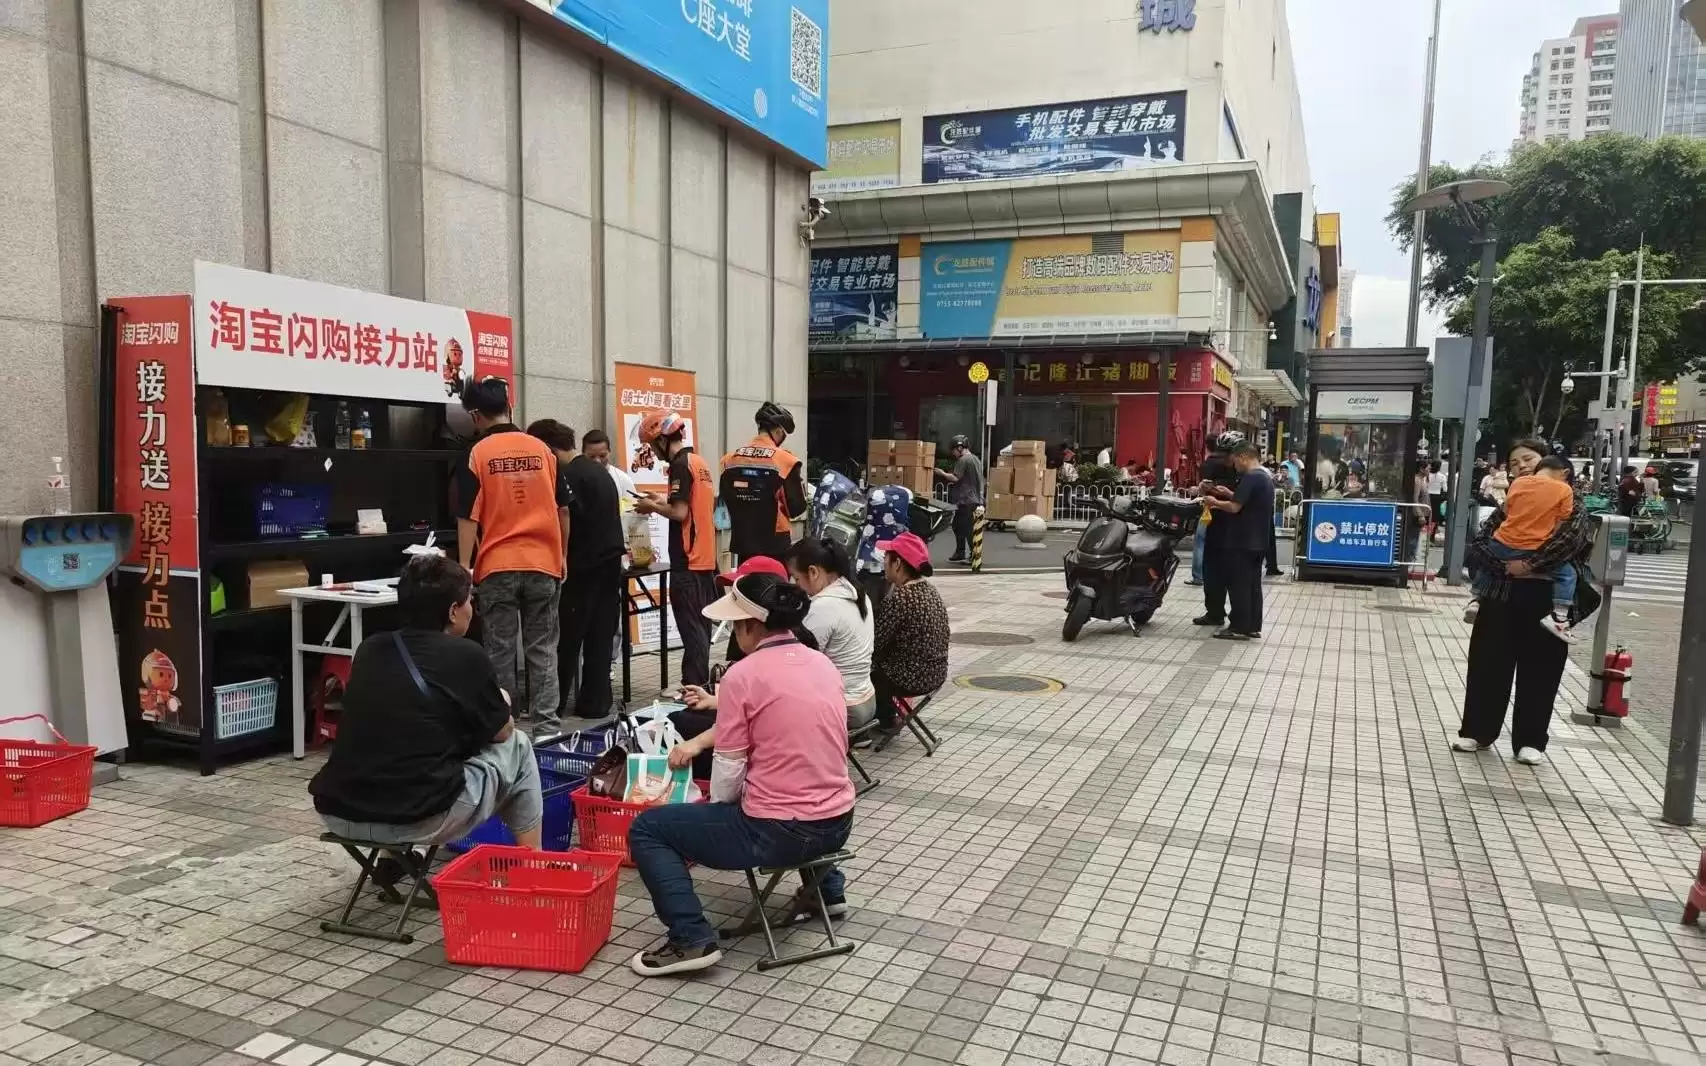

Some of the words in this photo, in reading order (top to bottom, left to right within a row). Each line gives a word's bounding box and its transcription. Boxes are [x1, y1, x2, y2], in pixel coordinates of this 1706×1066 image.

[1015, 108, 1085, 128] 手机配件
[1092, 100, 1167, 120] 智能穿戴
[1029, 114, 1176, 141] 批发交易专业市场
[837, 255, 891, 273] 智能穿戴
[1021, 251, 1174, 279] 打造高端品牌数码配件交易市场
[809, 273, 896, 291] 交易专业市场
[121, 322, 178, 346] 淘宝闪购
[210, 301, 438, 373] 淘宝闪购接力站
[622, 390, 691, 410] 骑士小哥看这里
[136, 360, 170, 490] 接力送
[489, 456, 542, 474] 淘宝闪购
[1340, 521, 1389, 536] 禁止停放
[140, 502, 172, 629] 接力点
